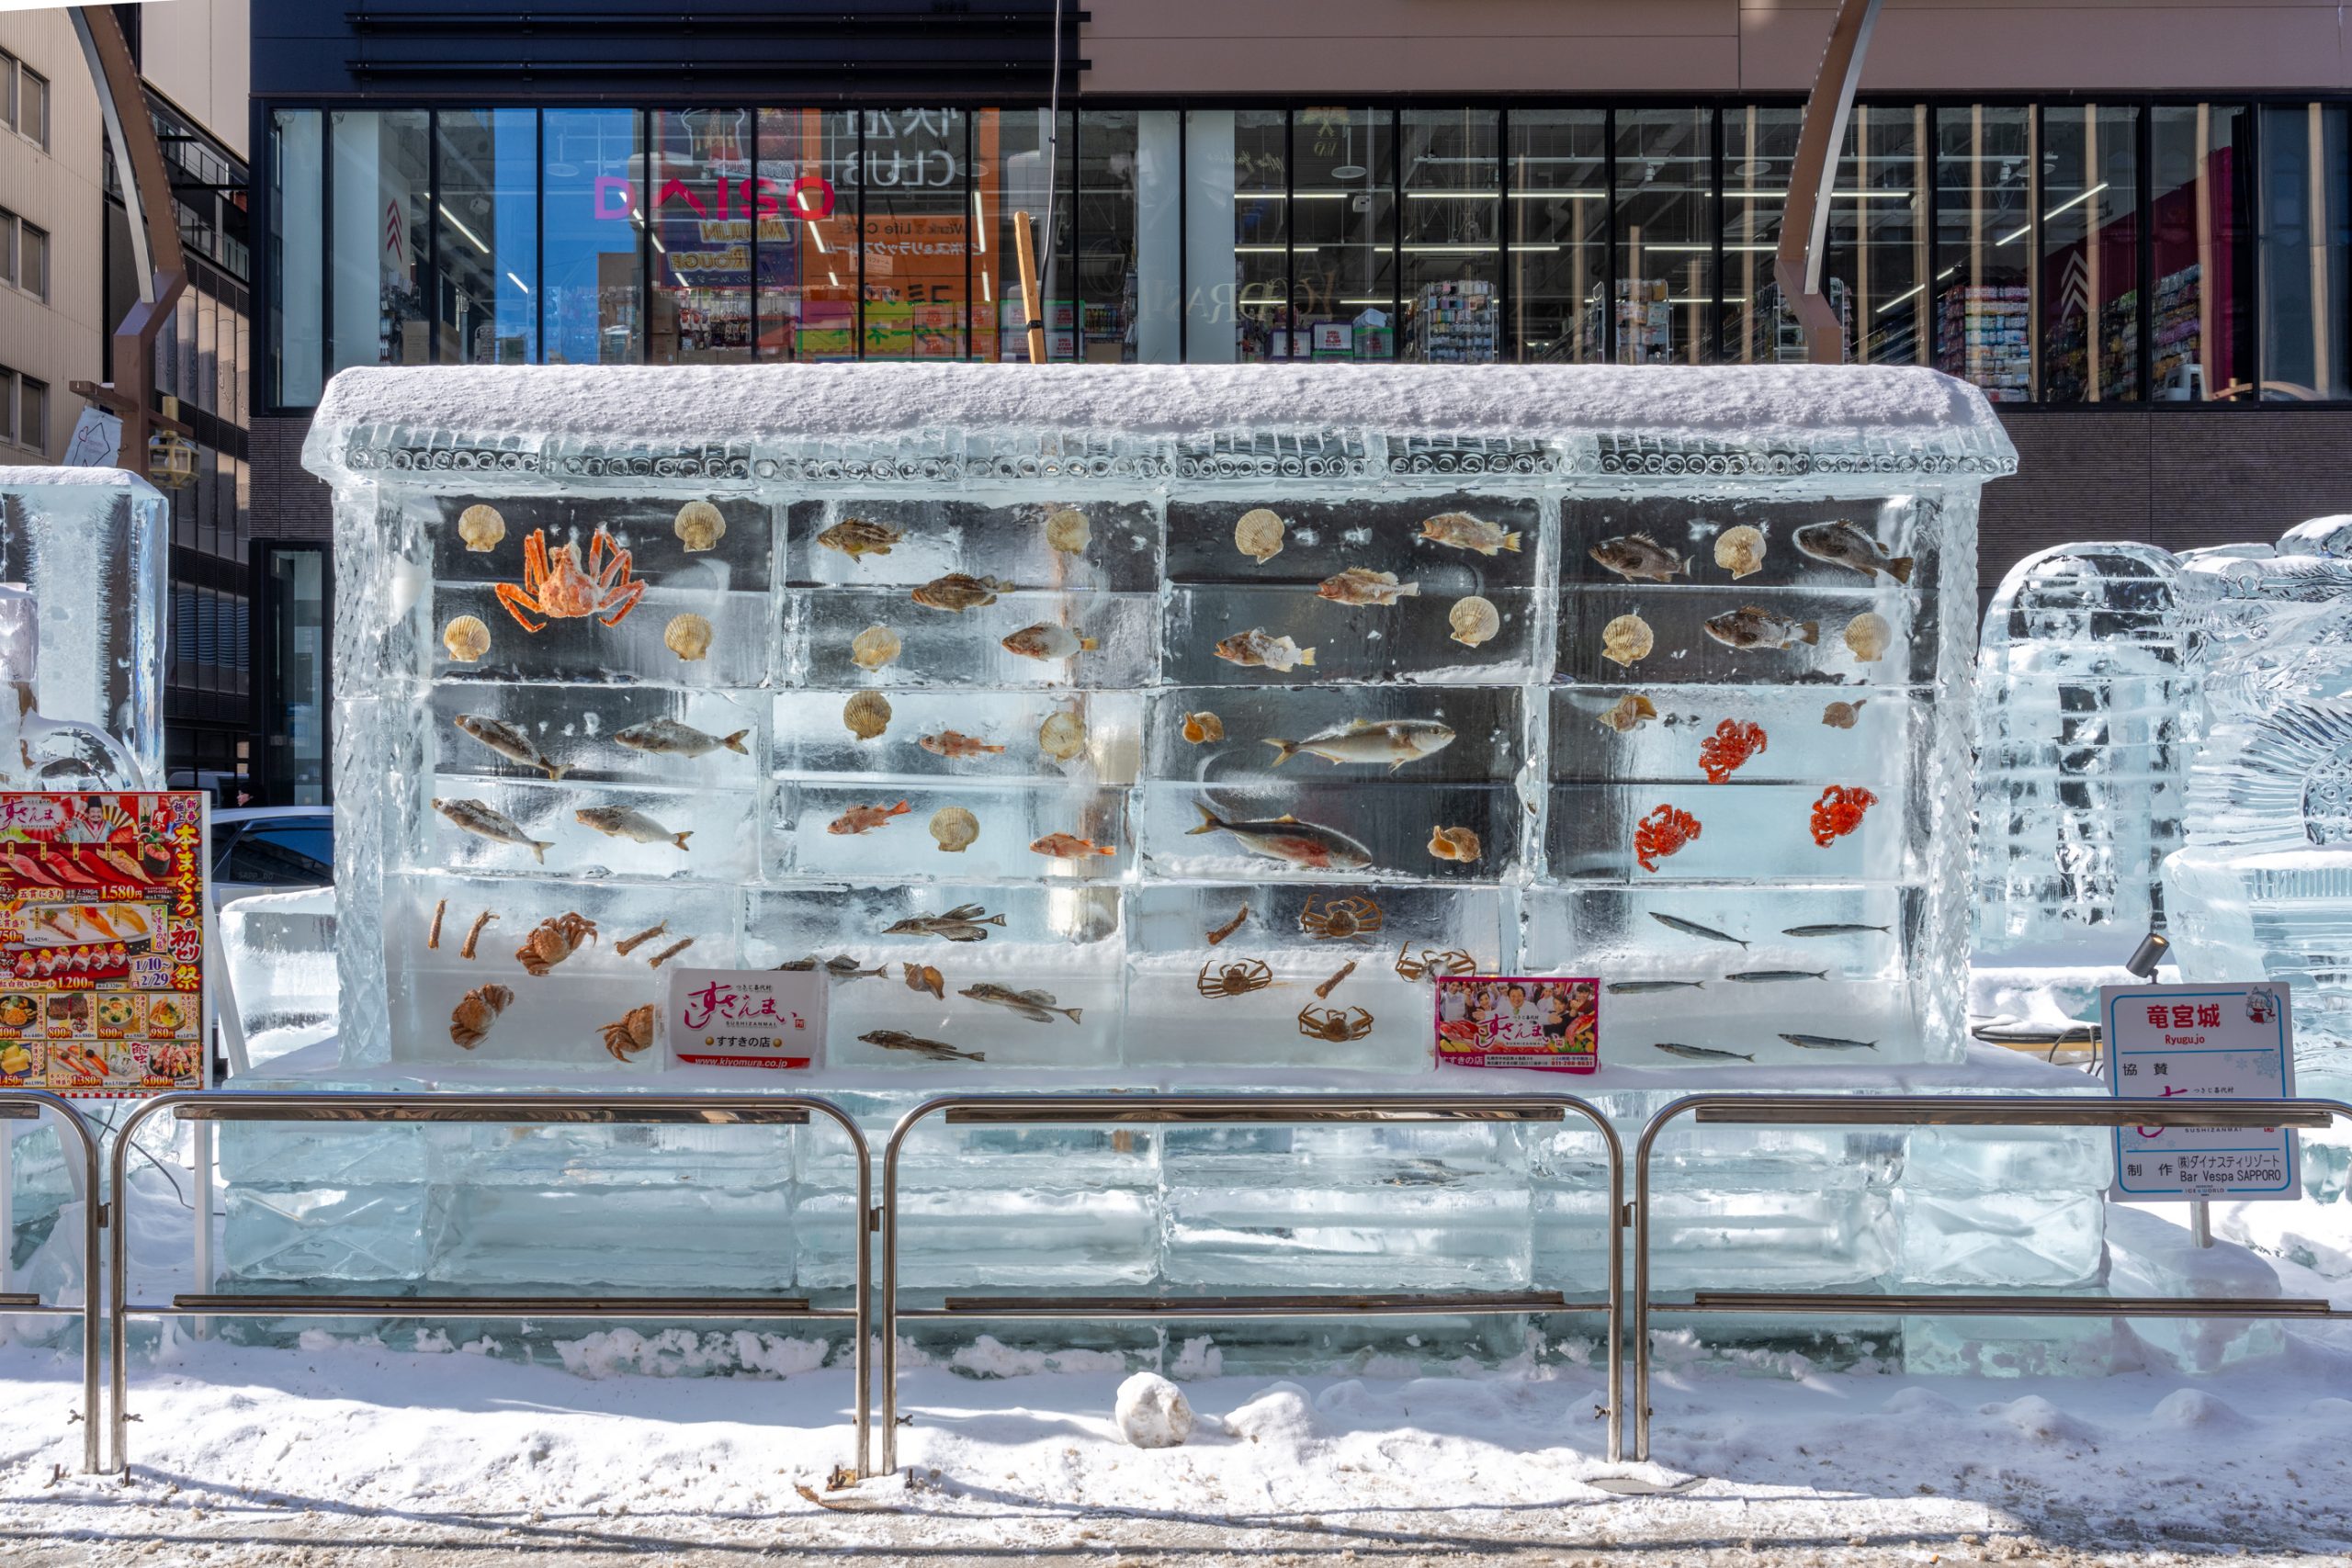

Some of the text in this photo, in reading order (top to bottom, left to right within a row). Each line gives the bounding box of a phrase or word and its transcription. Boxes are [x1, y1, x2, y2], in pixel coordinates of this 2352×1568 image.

[594, 176, 835, 220] DAISO
[187, 797, 197, 821] 新春
[172, 823, 200, 916] 本まぐろ
[19, 888, 63, 898] 五貫にぎり
[155, 908, 164, 949] すすきの店
[141, 974, 169, 986] 2/29
[172, 964, 201, 990] 祭
[736, 984, 772, 992] つきじ喜代村
[2146, 1003, 2221, 1030] 竜宮城
[726, 1020, 778, 1028] SUSHIZANMAI
[48, 1027, 72, 1038] 800円
[99, 1027, 123, 1038] 800円
[717, 1036, 771, 1048] すすきの店
[2165, 1033, 2205, 1045] Ryugujo
[2180, 1169, 2281, 1183] Bar Vespa SAPPORO
